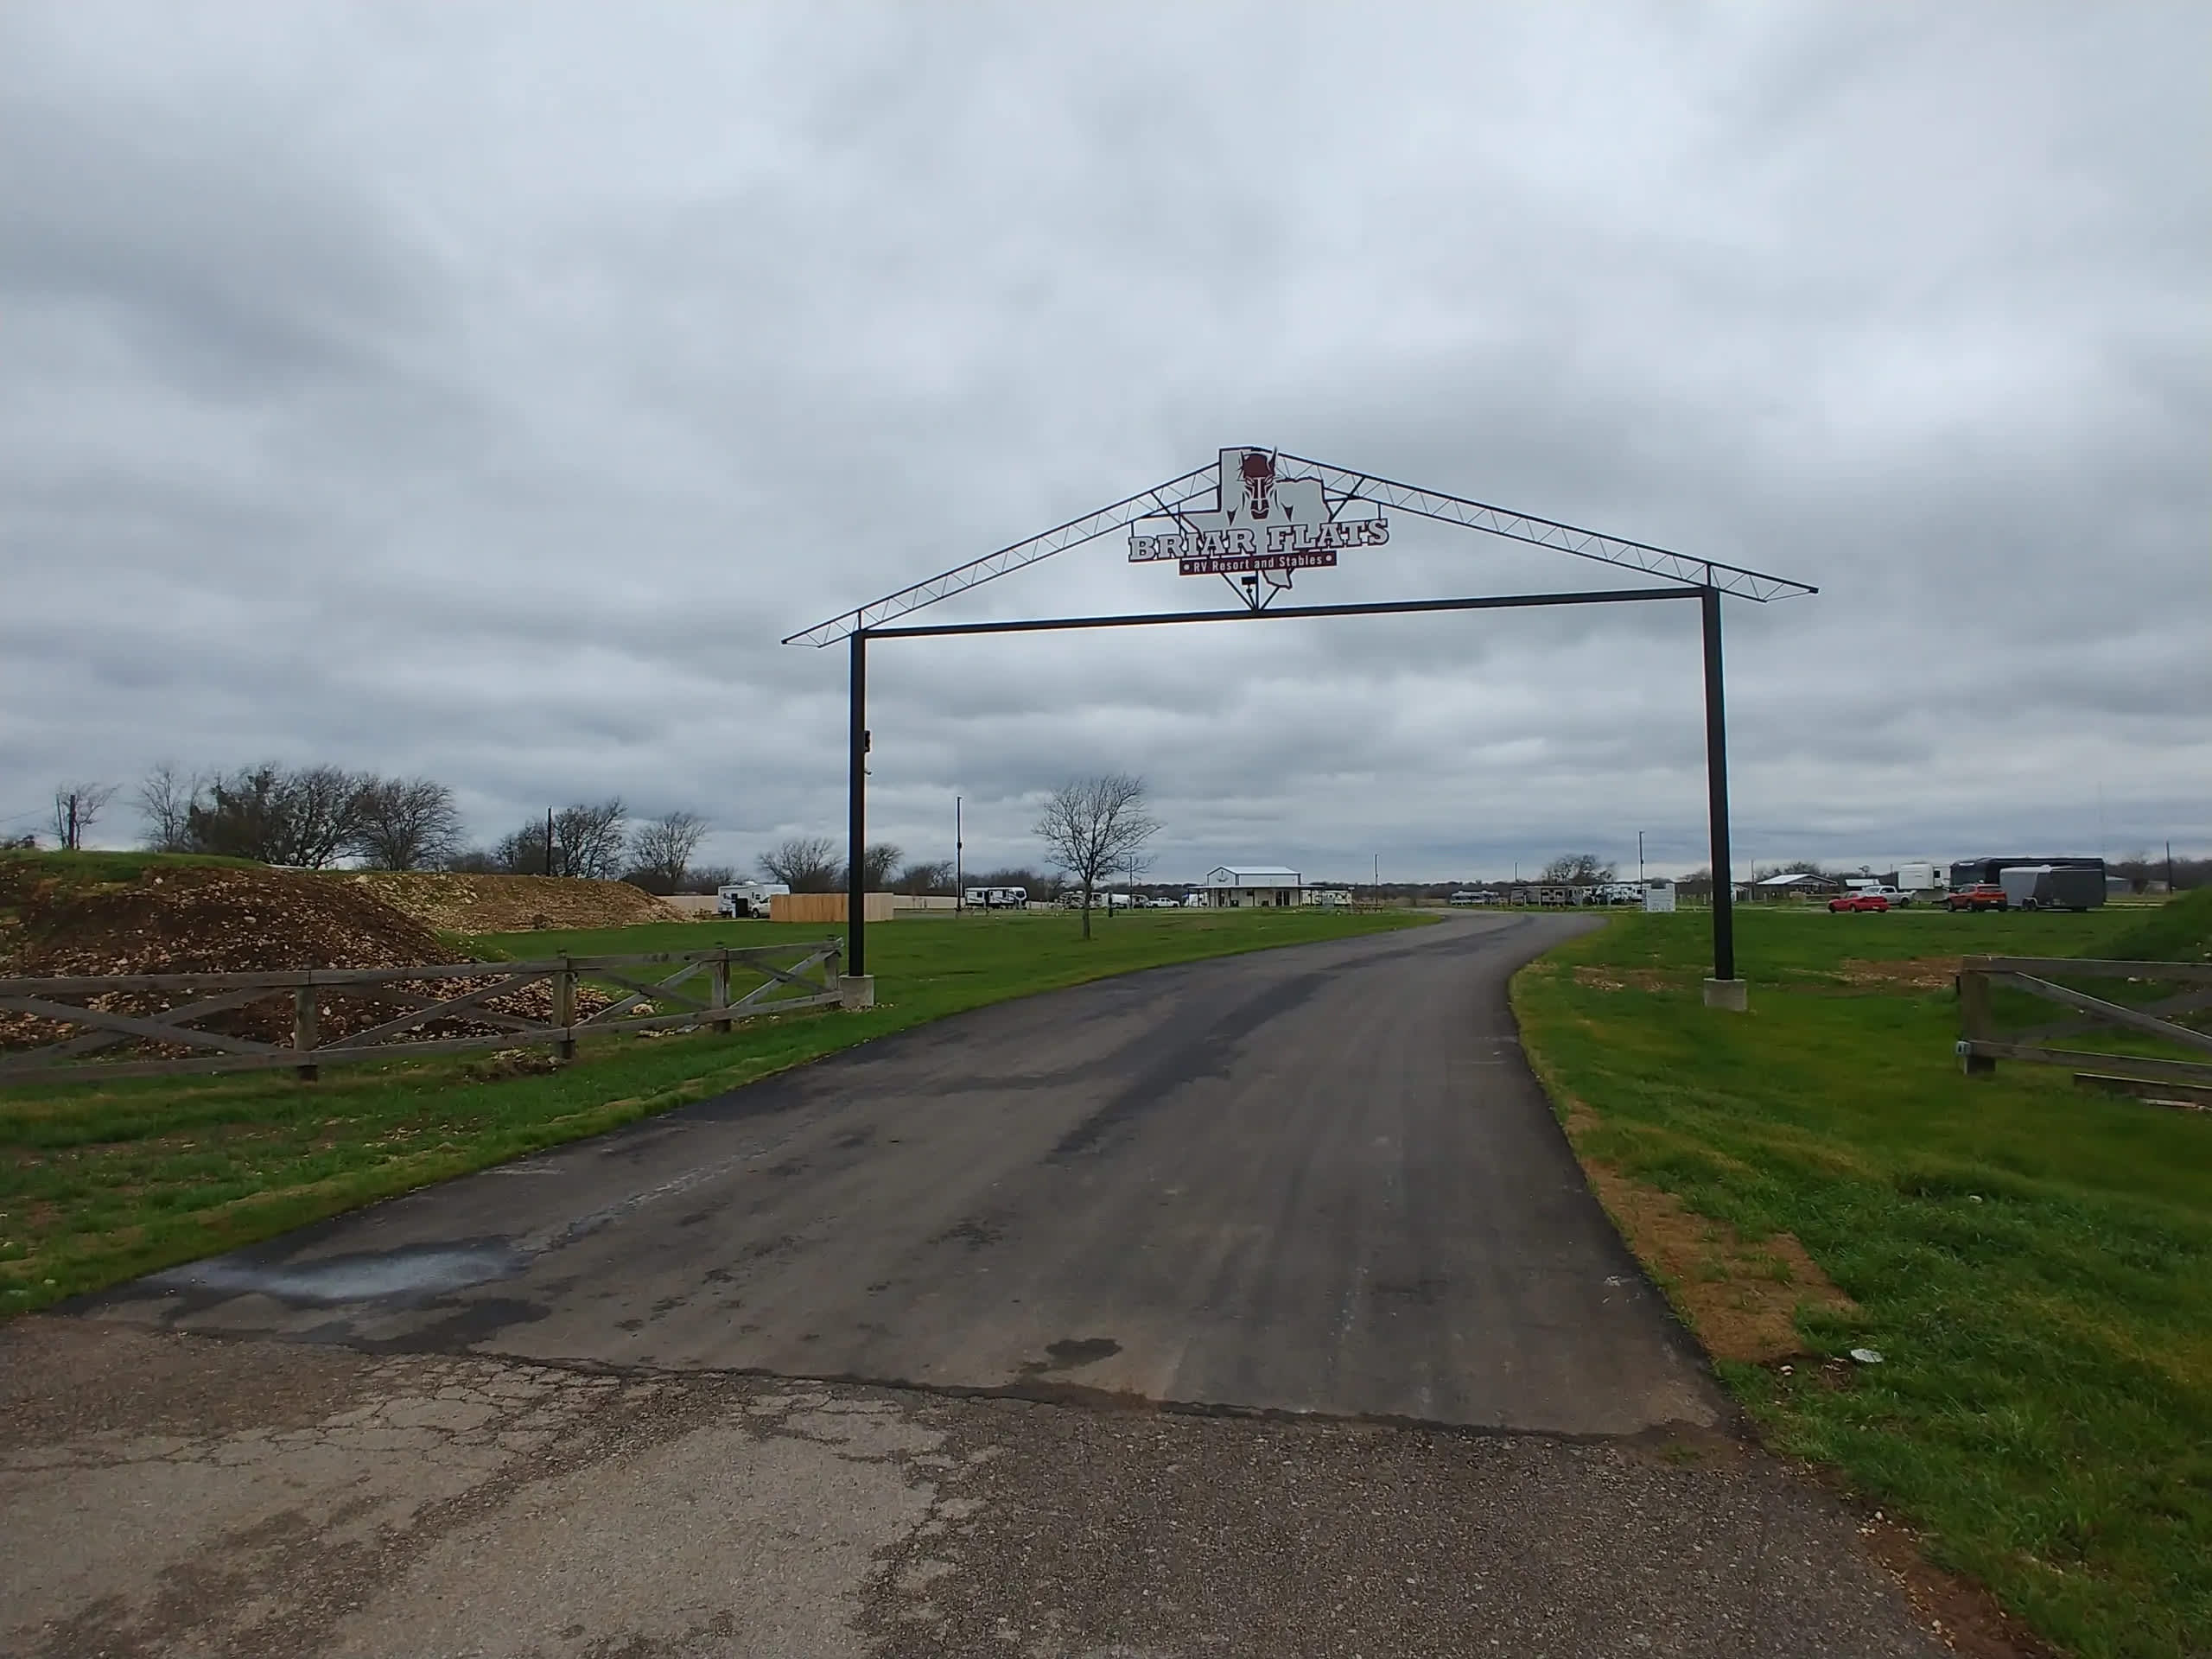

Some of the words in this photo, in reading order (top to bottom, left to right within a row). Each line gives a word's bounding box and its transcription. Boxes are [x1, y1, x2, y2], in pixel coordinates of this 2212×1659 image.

[1128, 529, 1256, 562] BRIAR
[1268, 519, 1389, 551] FLATS
[1193, 562, 1208, 572] RV
[1212, 560, 1249, 571] Resort
[1254, 557, 1274, 569] and
[1279, 555, 1323, 567] Stables
